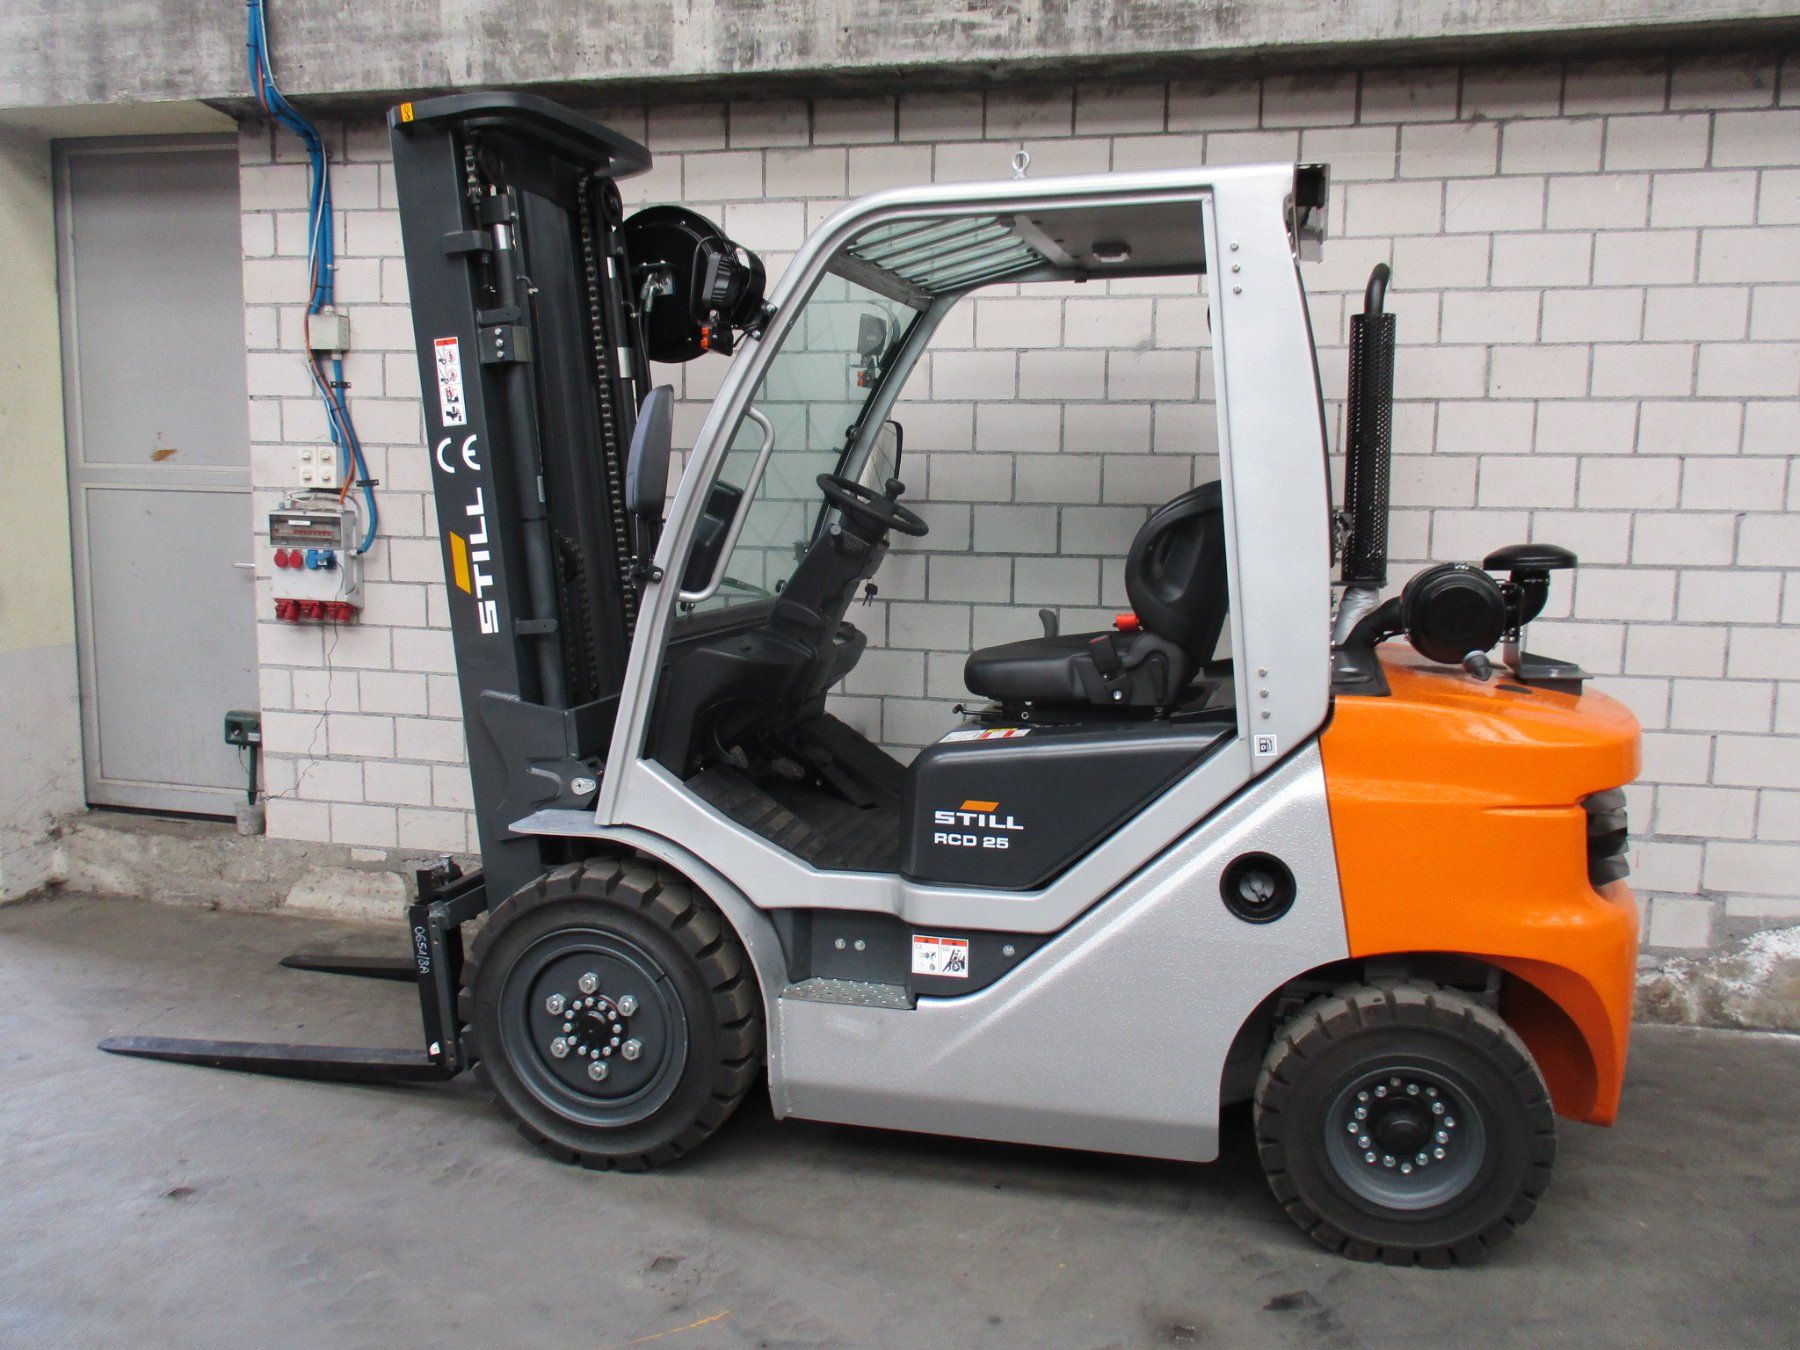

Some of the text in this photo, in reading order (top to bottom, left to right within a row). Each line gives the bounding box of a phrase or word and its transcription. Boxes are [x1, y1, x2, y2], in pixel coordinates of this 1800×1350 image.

[437, 434, 481, 474] CE
[466, 487, 499, 634] STILL
[935, 811, 1024, 830] STILL
[934, 832, 1009, 849] RCD 25
